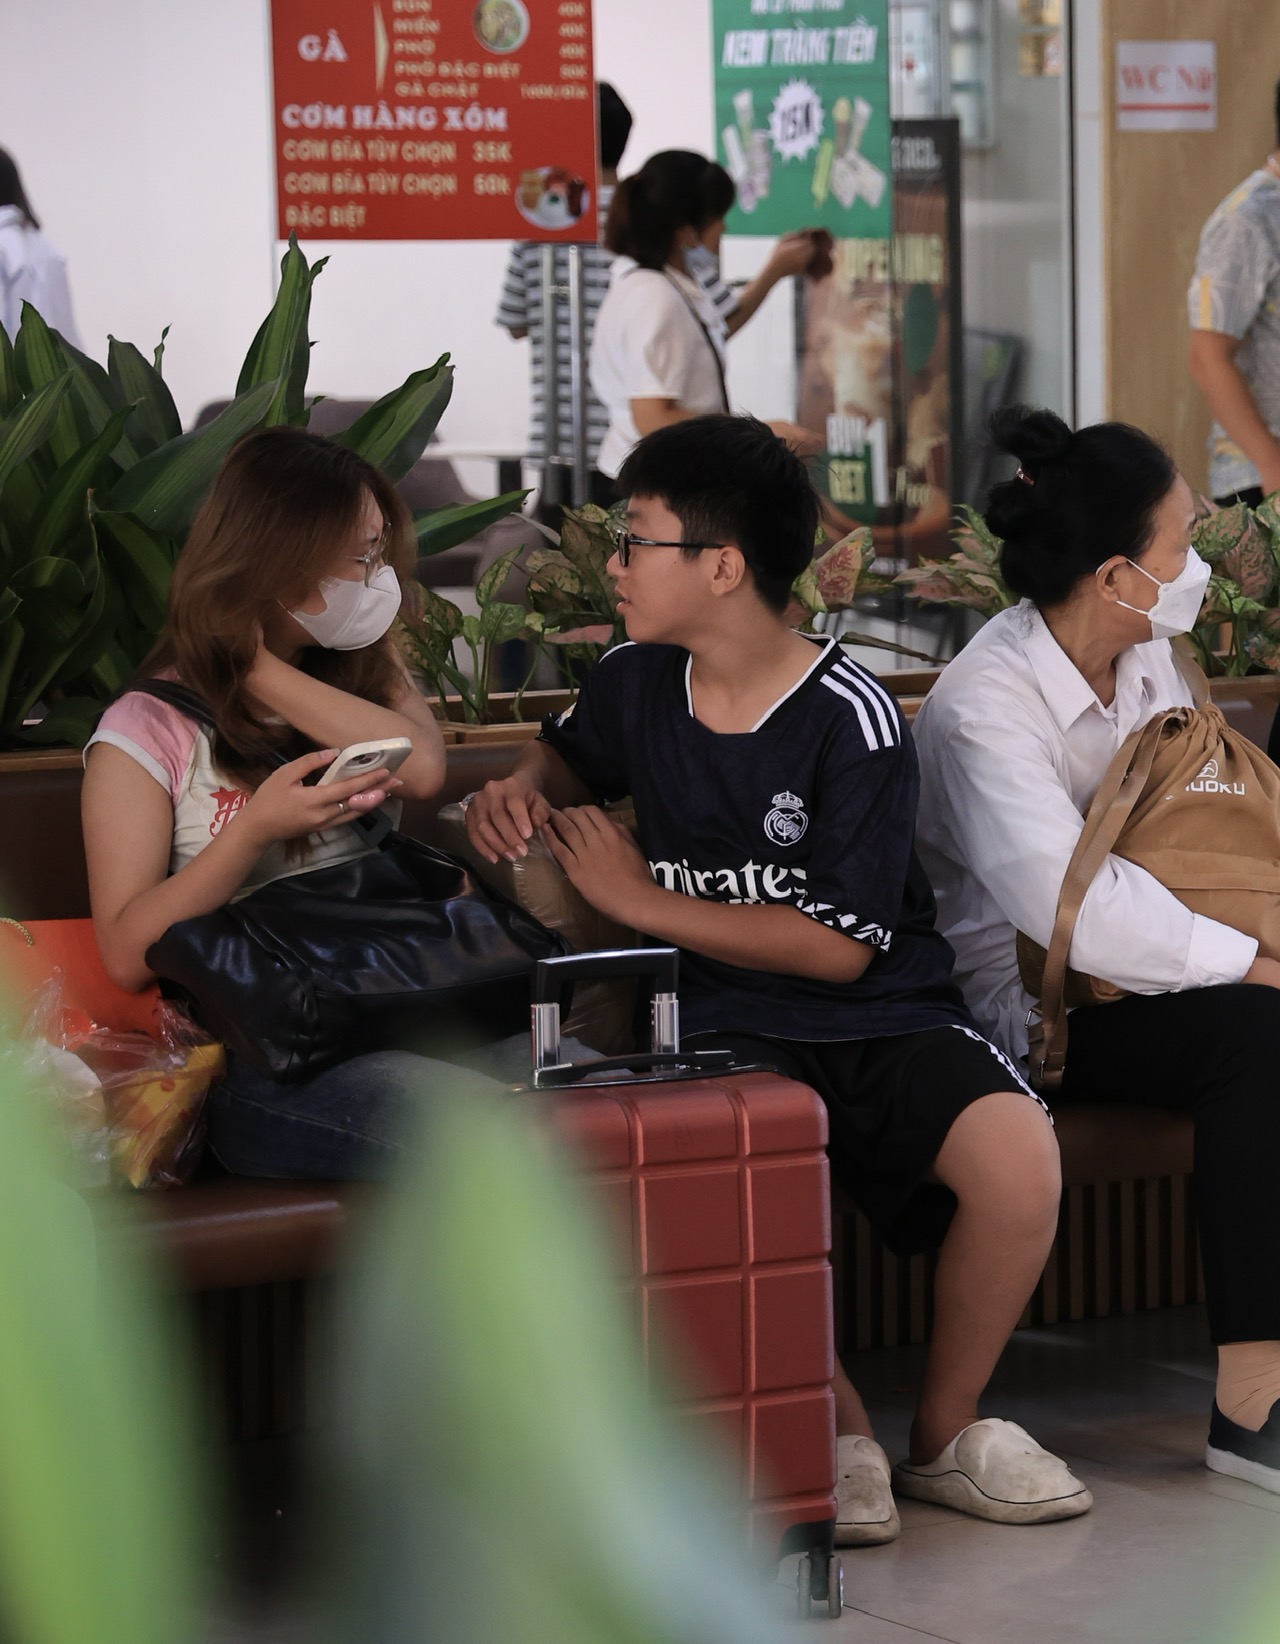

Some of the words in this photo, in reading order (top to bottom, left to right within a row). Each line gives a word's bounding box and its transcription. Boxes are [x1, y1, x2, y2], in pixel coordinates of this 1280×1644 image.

[298, 29, 347, 62] GÀ
[721, 29, 770, 68] KEM
[1121, 64, 1170, 94] WC
[282, 102, 346, 129] CƠM
[351, 101, 438, 130] HÀNG
[443, 102, 509, 131] XÓM
[283, 138, 329, 162] CƠM
[284, 171, 330, 195] CƠM
